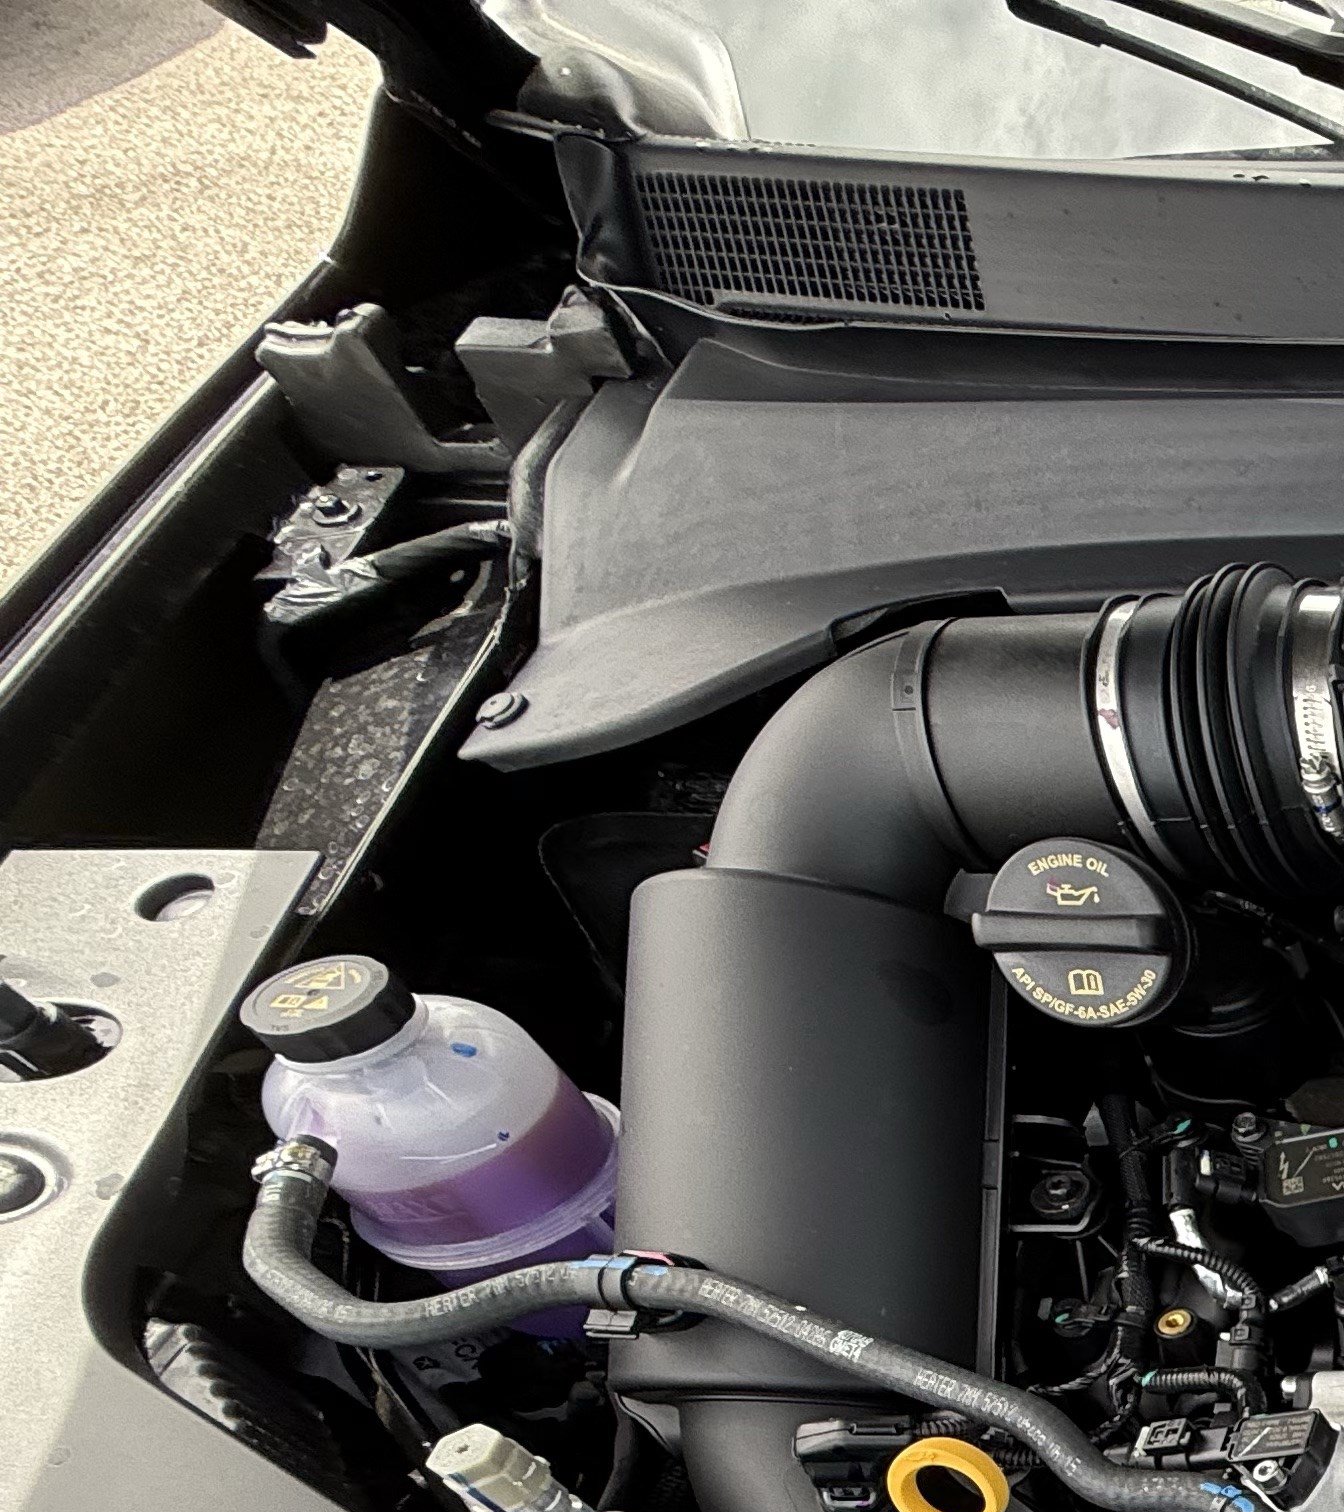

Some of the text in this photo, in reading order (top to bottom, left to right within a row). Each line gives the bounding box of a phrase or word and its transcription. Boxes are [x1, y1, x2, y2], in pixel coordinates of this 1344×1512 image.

[1028, 854, 1110, 877] ENGINE OIL
[1012, 967, 1036, 991] API
[913, 1368, 959, 1399] HEATER
